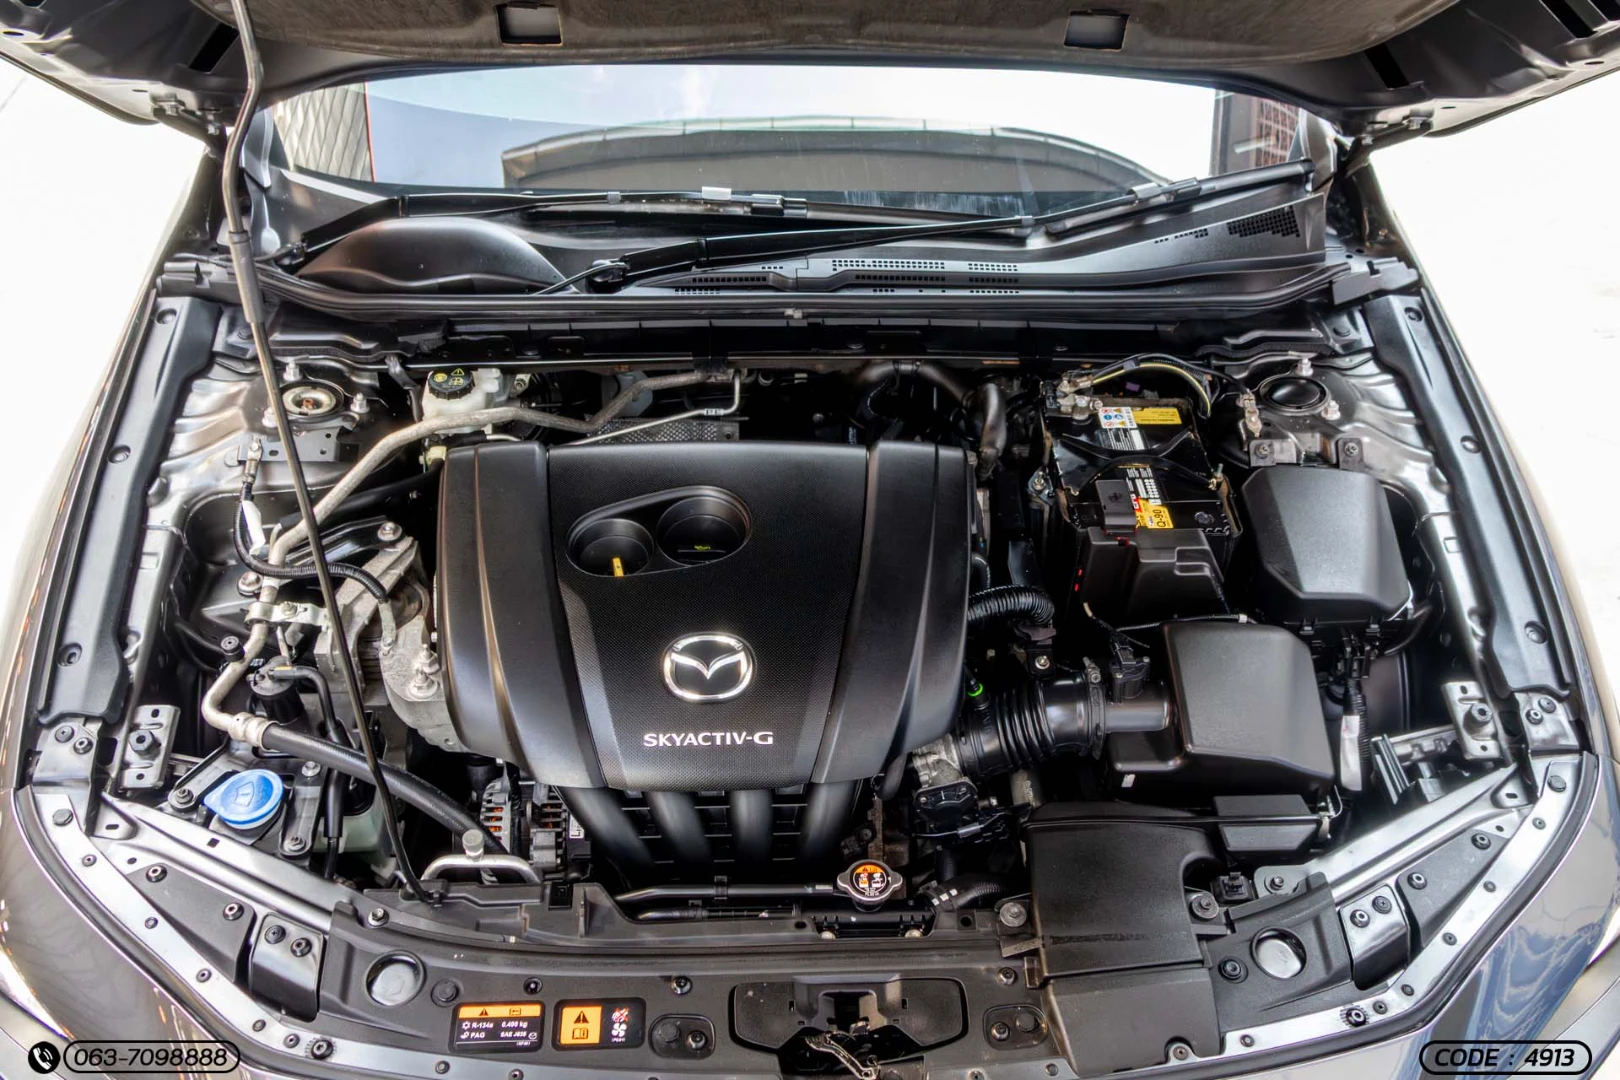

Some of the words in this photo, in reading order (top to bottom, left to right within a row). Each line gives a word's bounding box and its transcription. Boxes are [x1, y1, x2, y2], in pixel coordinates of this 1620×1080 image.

[1152, 509, 1167, 528] Q-90
[643, 731, 774, 747] SKYACTIV-G
[471, 1021, 494, 1029] R-134a
[519, 1020, 528, 1029] kg
